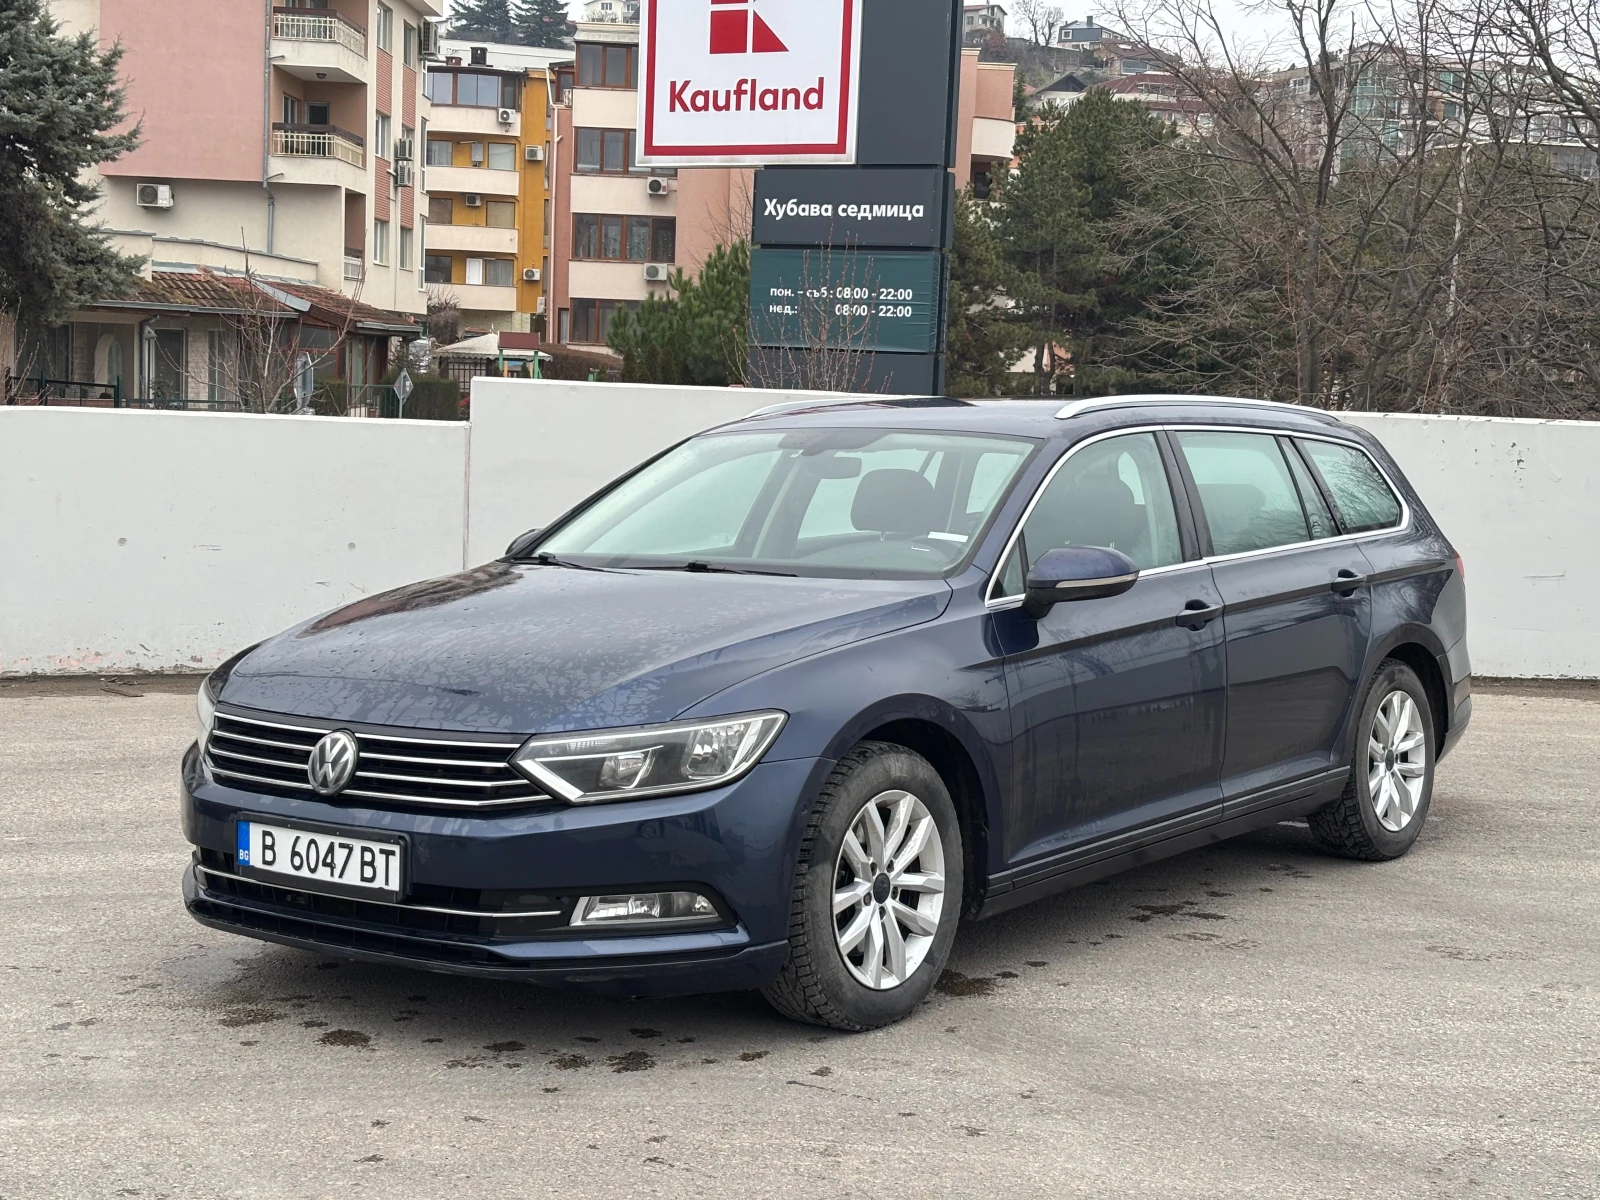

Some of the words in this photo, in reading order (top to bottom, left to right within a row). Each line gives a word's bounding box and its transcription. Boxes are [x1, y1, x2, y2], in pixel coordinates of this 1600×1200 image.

[669, 77, 824, 112] Kaufland
[764, 198, 833, 220] Хубава
[837, 203, 924, 221] седмица
[770, 288, 795, 297] пон.
[836, 287, 869, 299] 08:00
[879, 288, 913, 300] 22:00
[769, 304, 798, 316] нед.:
[835, 304, 868, 317] 08:00
[878, 305, 912, 318] 22:00
[239, 849, 249, 861] BG
[261, 829, 277, 866] B
[290, 835, 354, 879] 6047
[360, 845, 397, 886] BT
